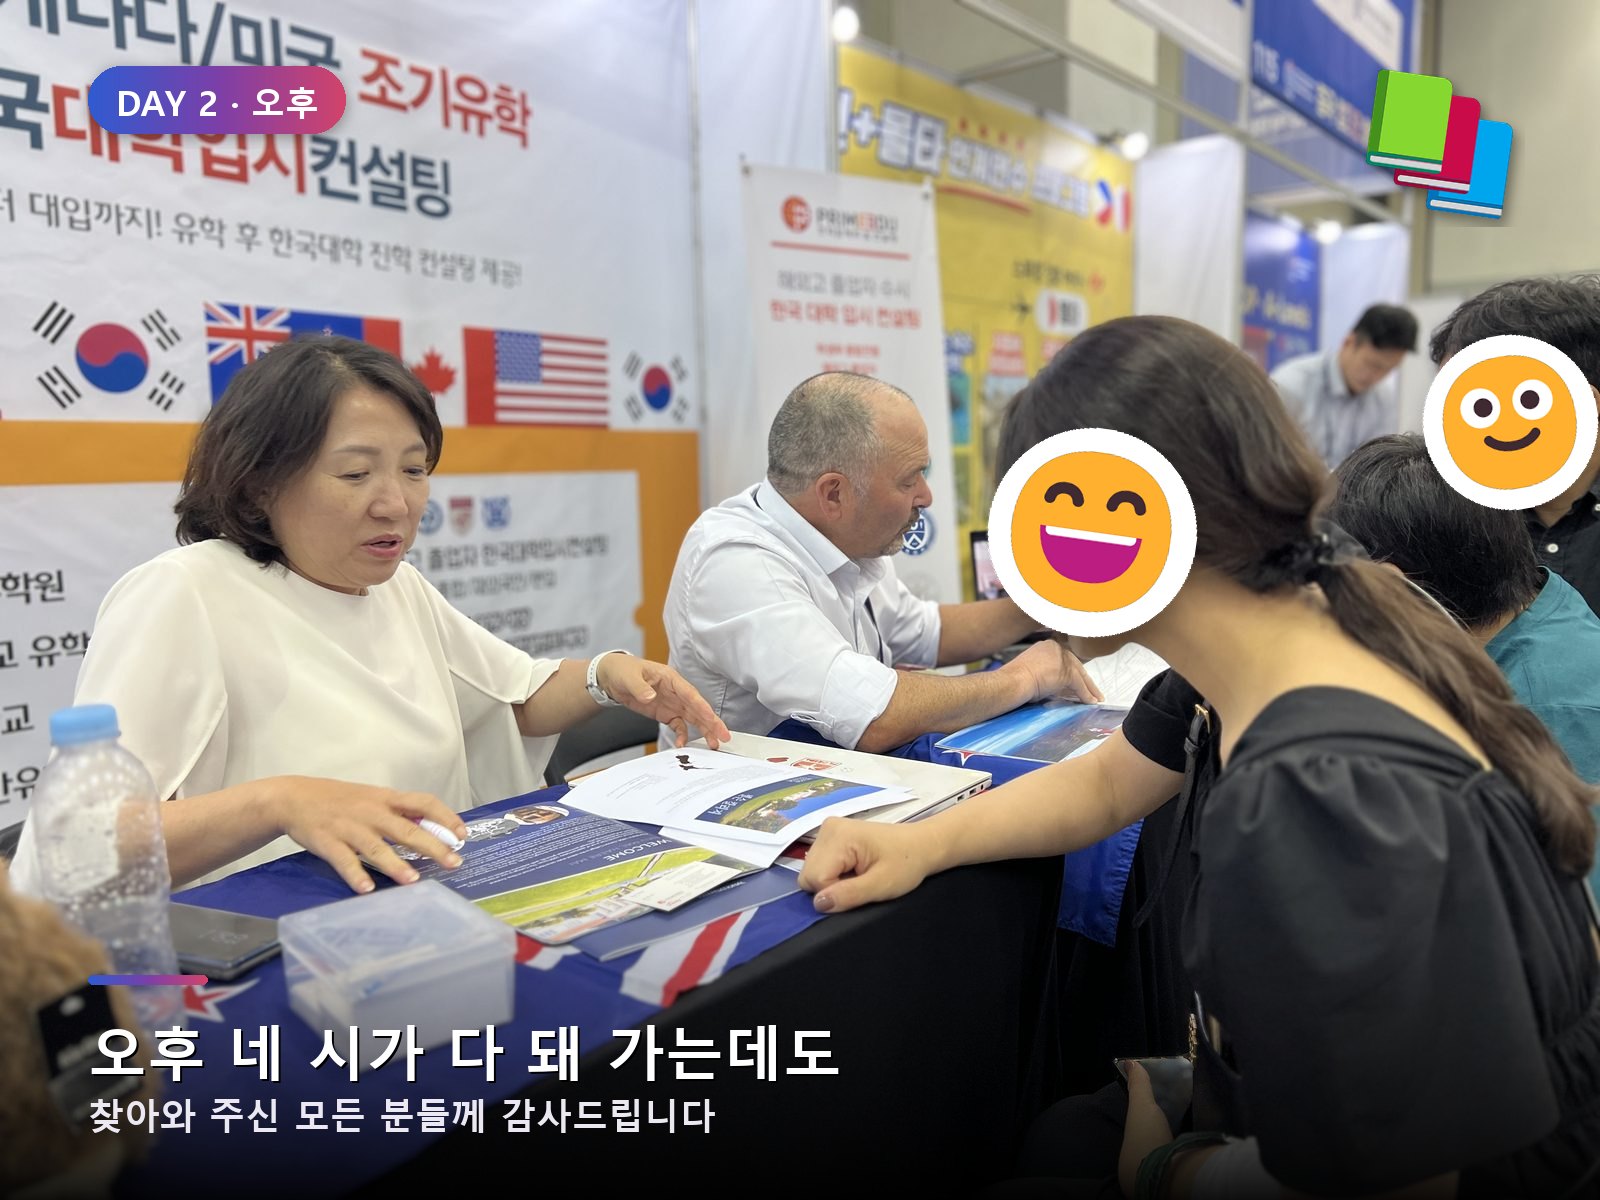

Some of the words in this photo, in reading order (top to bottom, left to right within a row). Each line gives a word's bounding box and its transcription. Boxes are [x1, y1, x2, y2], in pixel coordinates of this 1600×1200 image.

[358, 46, 533, 148] 조기유학
[29, 190, 163, 240] 대입까지!
[171, 211, 228, 249] 유학
[234, 221, 263, 254] 후
[268, 226, 363, 268] 한국대학
[369, 240, 413, 274] 진학
[417, 247, 477, 284] 컨설팅
[879, 279, 912, 301] 수시
[769, 299, 802, 322] 한국
[805, 302, 839, 325] 대학
[842, 305, 874, 327] 입시
[875, 305, 922, 330] 컨설팅
[428, 546, 478, 572] 졸업자
[1, 703, 34, 735] 교
[602, 838, 672, 862] WELCOME
